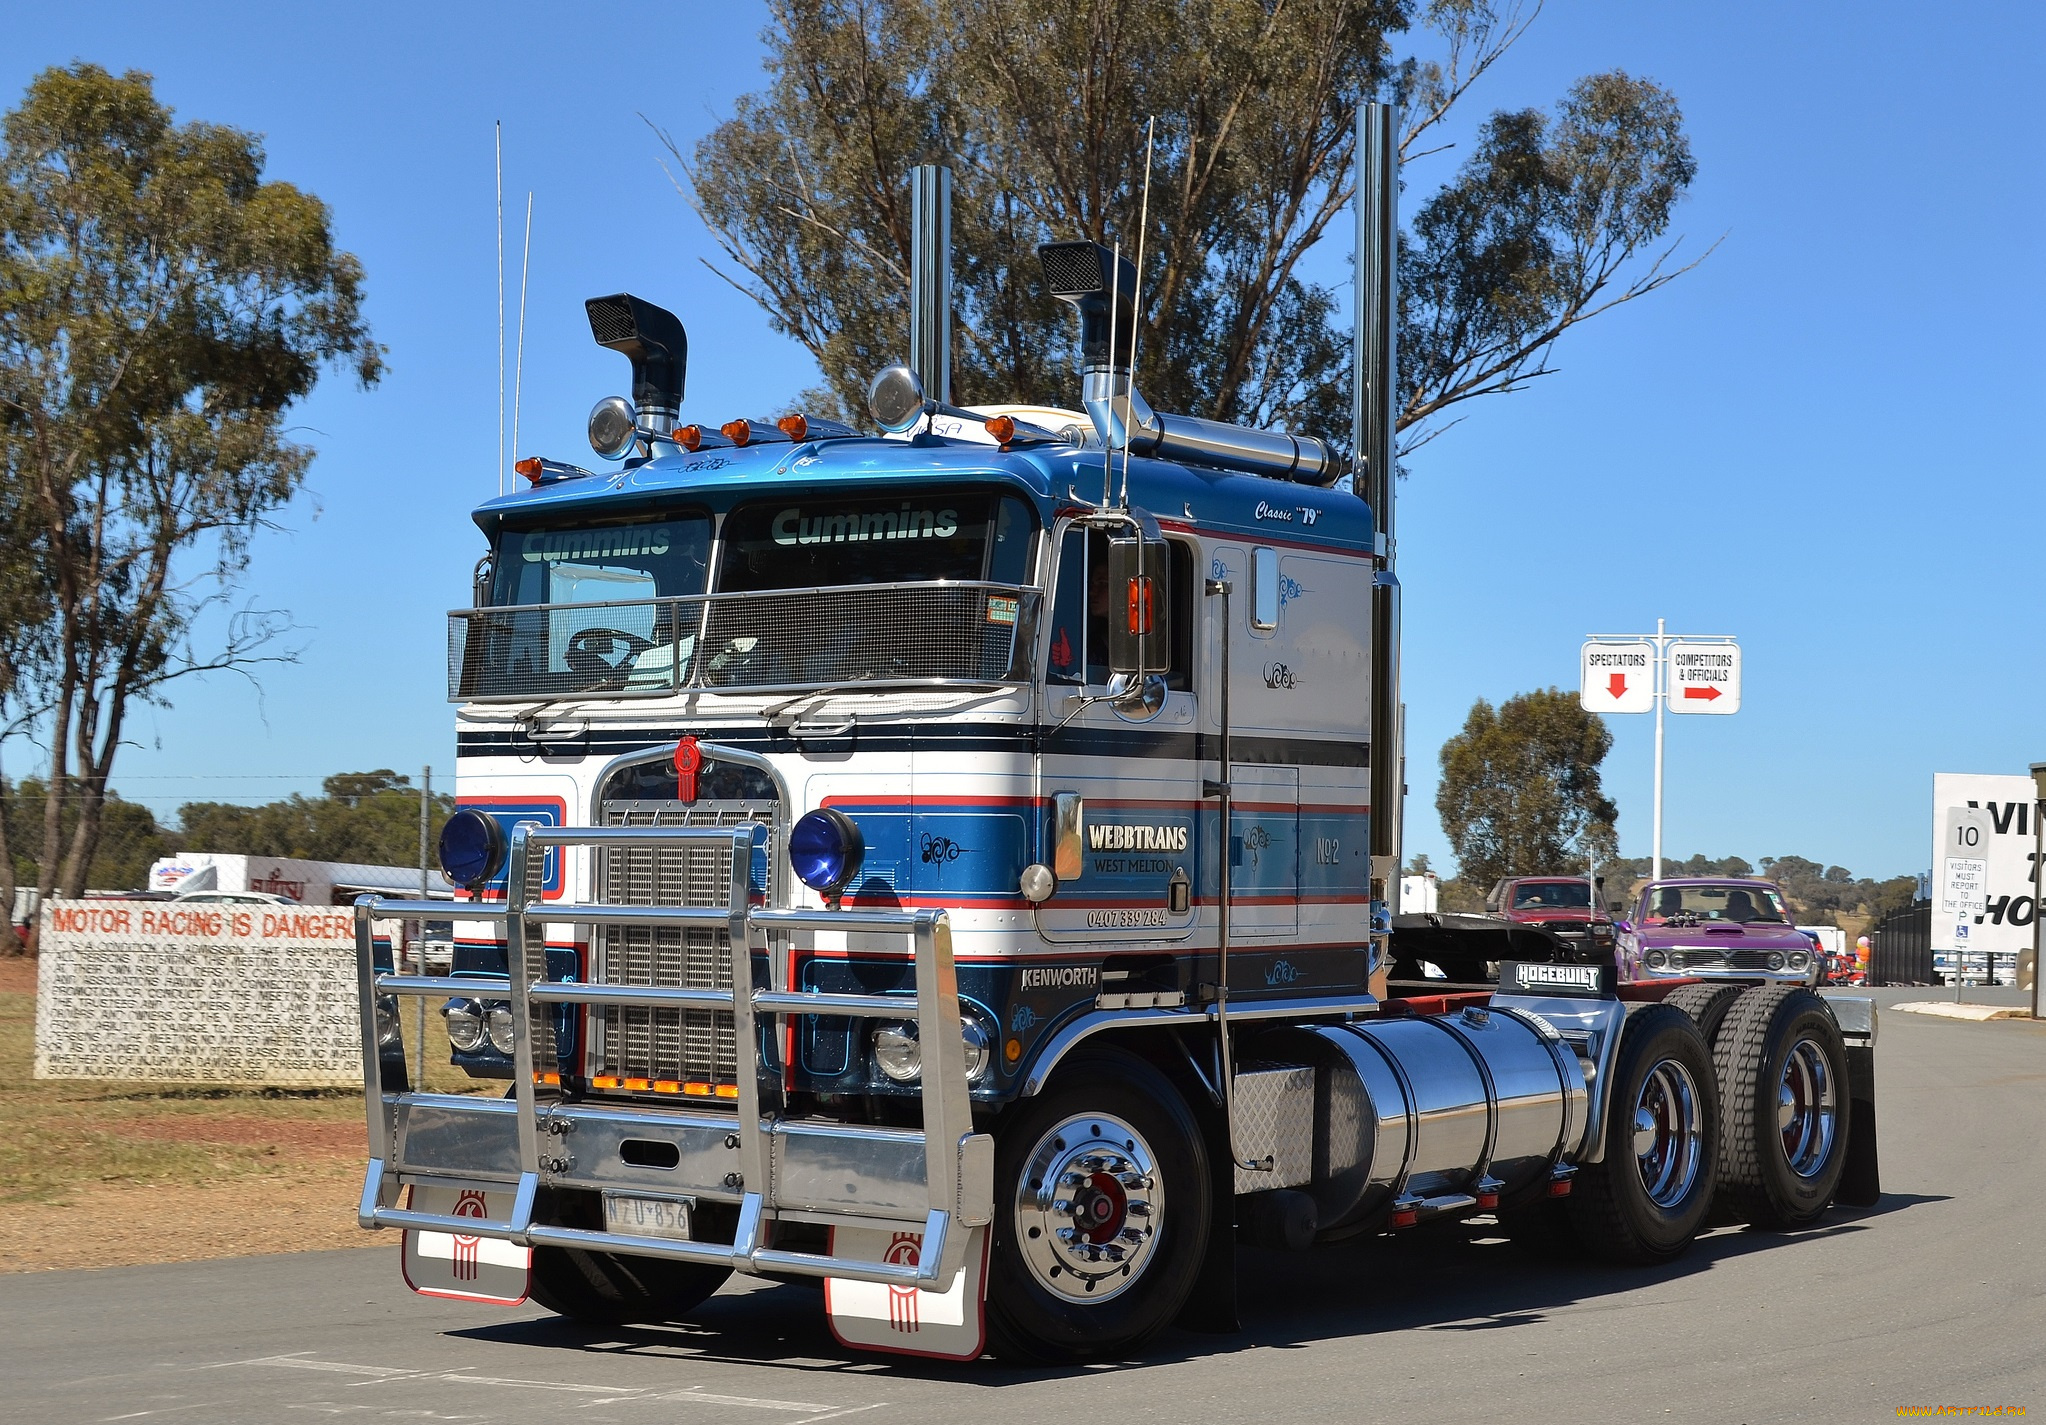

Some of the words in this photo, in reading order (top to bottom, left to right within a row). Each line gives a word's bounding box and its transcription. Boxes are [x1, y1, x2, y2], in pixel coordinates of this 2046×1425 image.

[1254, 500, 1293, 521] Classic
[772, 502, 958, 545] Cummins
[521, 521, 671, 563] Cummins
[1589, 653, 1646, 667] SPECTATORS
[1675, 653, 1732, 667] COMPETITORS
[1679, 668, 1685, 681] &
[1687, 669, 1728, 682] OFFICIALS
[1088, 824, 1187, 852] WEBBTRANS
[1957, 825, 1979, 847] 10
[1095, 859, 1126, 873] WEST
[1128, 859, 1174, 873] MELTON
[1950, 862, 1982, 872] VISITORS
[1951, 881, 1979, 890] REPORT
[1955, 872, 1975, 881] MUST
[1960, 891, 1969, 900] TO
[1944, 900, 1958, 909] THE
[1959, 901, 1984, 911] OFFICE
[53, 908, 131, 933] MOTOR
[141, 910, 221, 935] RACING
[232, 912, 251, 936] IS
[1087, 910, 1120, 928] 0407
[1120, 910, 1142, 927] 339
[1143, 909, 1168, 927] 284
[1021, 967, 1097, 988] KENWORTH
[1516, 964, 1599, 990] HOGEBUILT
[654, 1202, 687, 1230] 856
